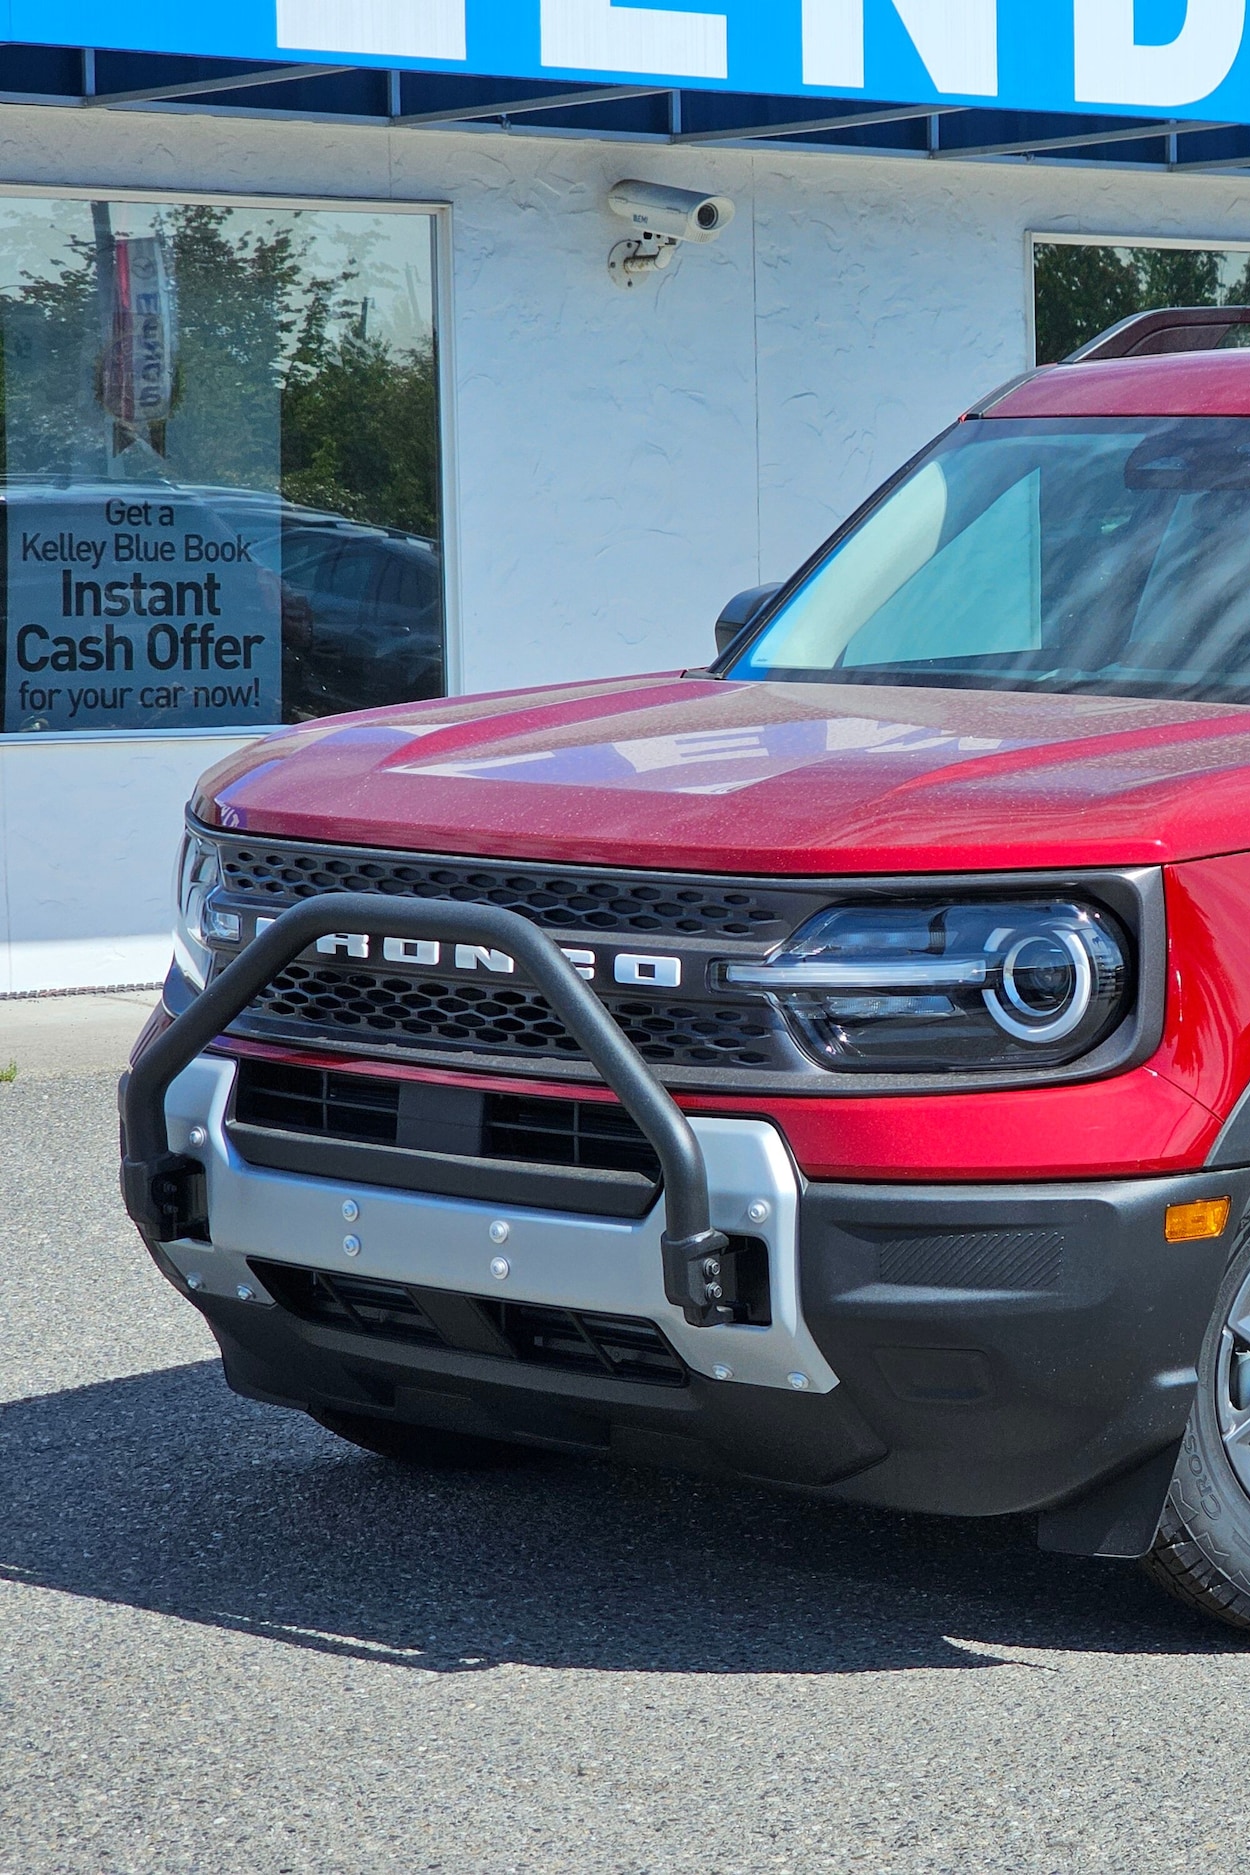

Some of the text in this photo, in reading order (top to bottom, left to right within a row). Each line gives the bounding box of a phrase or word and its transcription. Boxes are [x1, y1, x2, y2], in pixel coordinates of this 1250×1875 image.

[105, 498, 174, 526] Get a
[22, 532, 252, 569] Kelley Blue Book
[62, 569, 221, 617] Instant
[17, 622, 266, 673] Cash Offer
[19, 677, 260, 717] for your car now!
